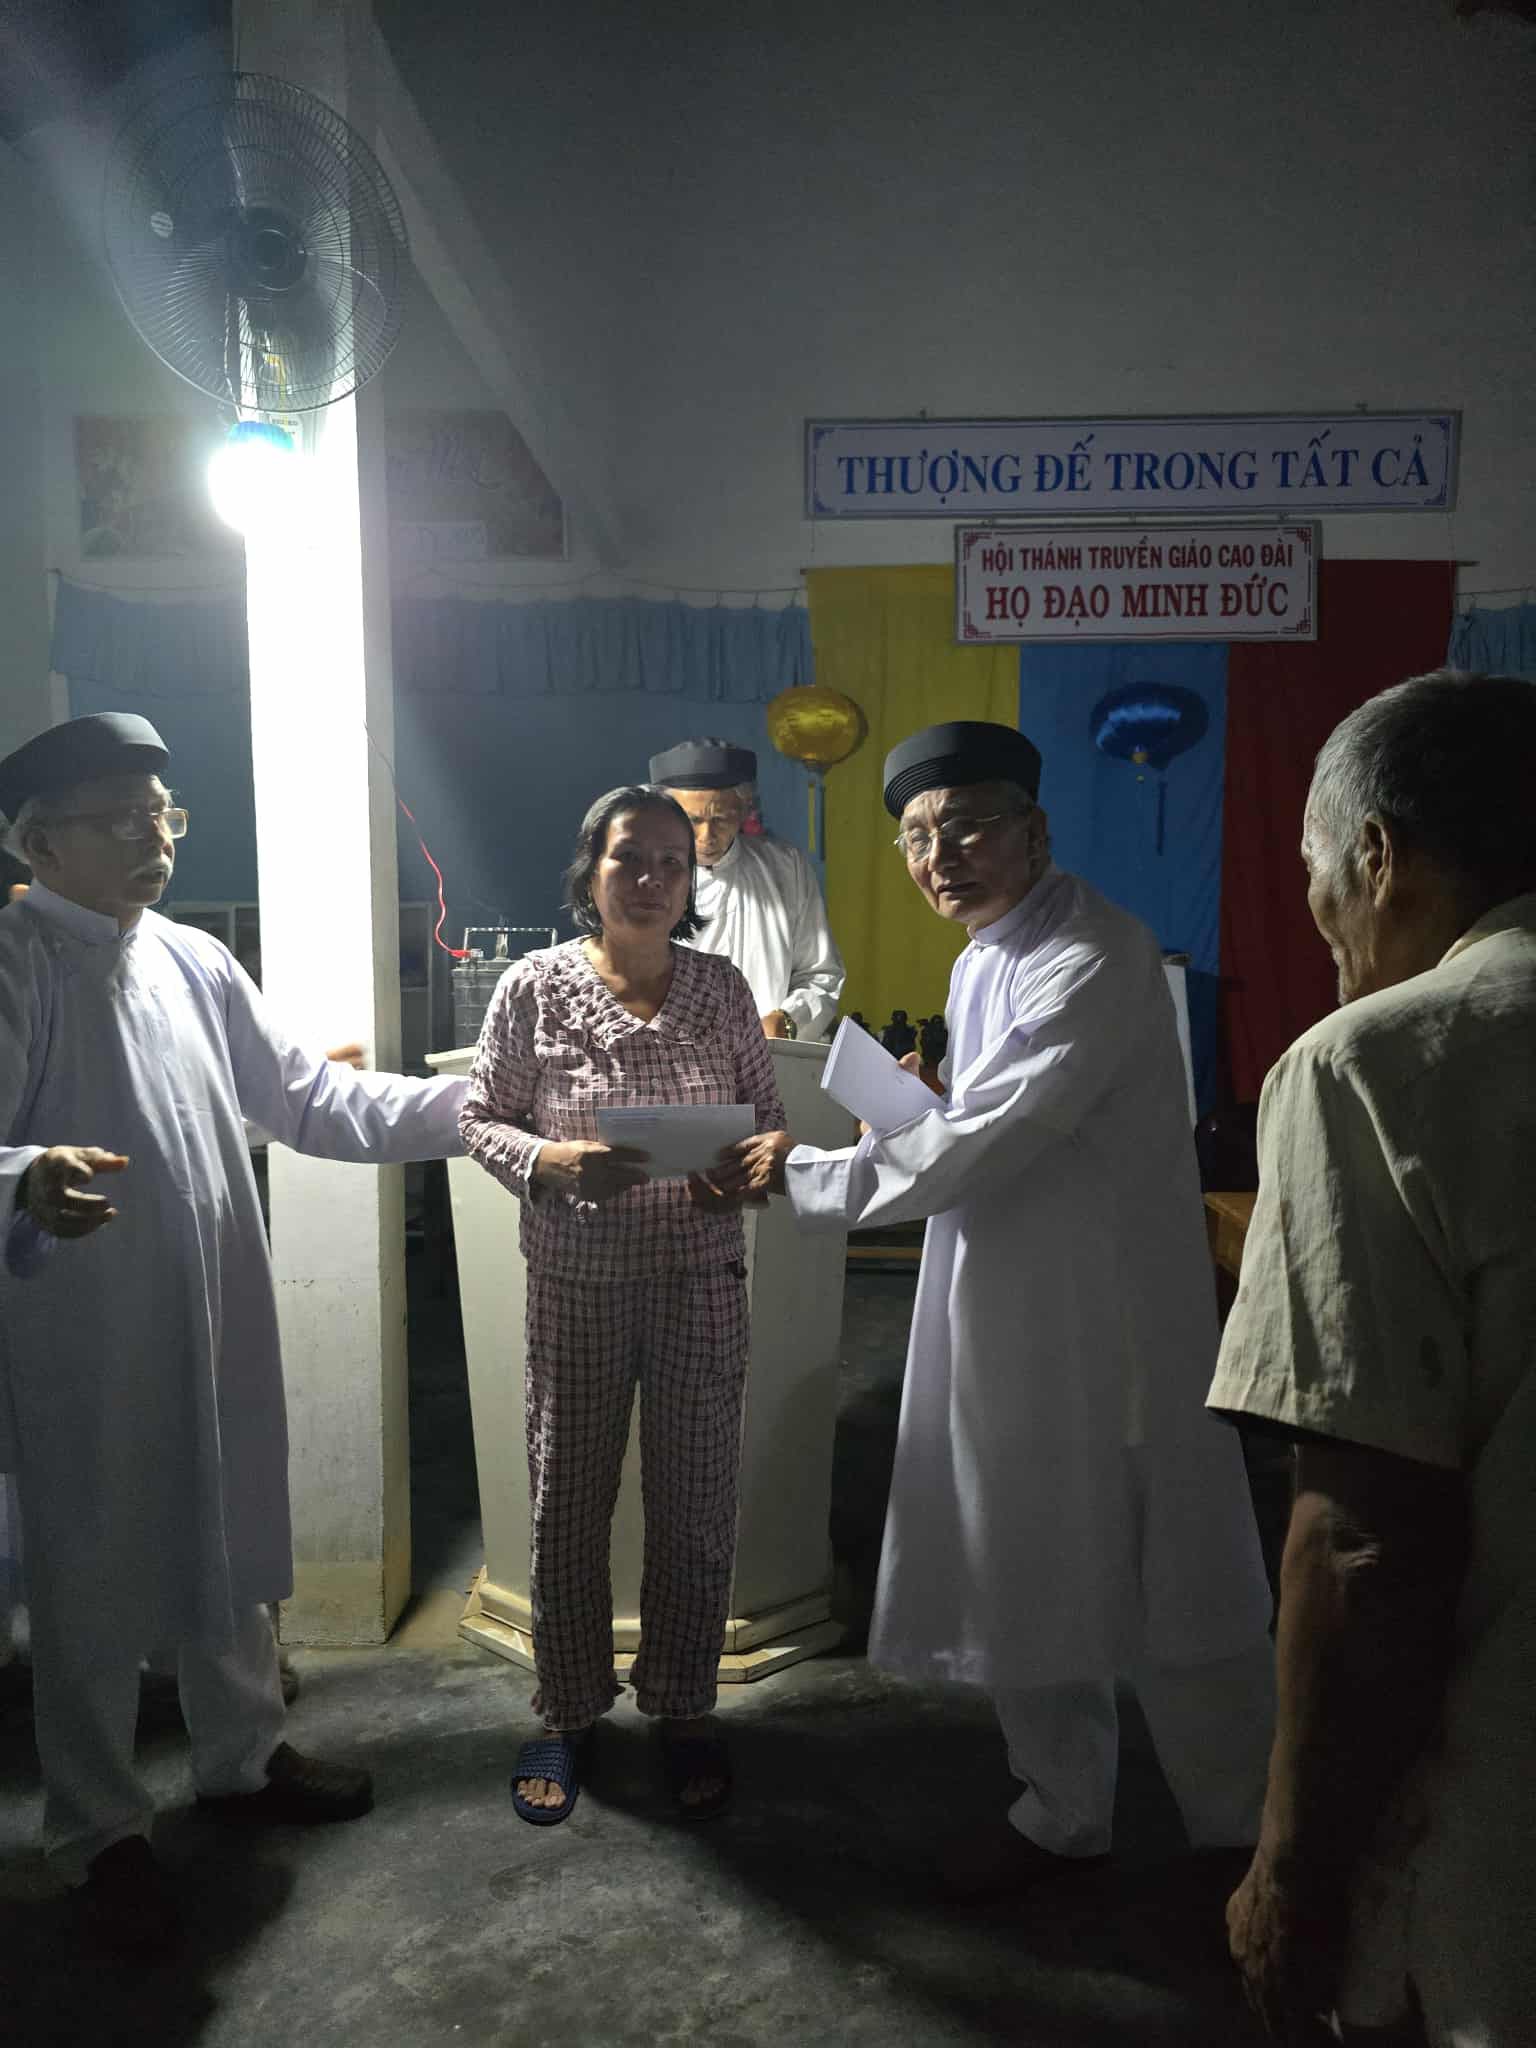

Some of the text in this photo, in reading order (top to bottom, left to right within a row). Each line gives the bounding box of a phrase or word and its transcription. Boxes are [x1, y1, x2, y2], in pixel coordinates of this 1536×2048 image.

[837, 429, 1430, 504] THƯỢNG ĐẾ TRONG TẤT CẢ
[982, 541, 1013, 576] HỘI
[1020, 540, 1082, 571] THÁNH
[1168, 539, 1211, 568] GIÁO
[1218, 544, 1254, 568] CAO
[985, 572, 1289, 628] HỌ ĐẠO MINH ĐỨC
